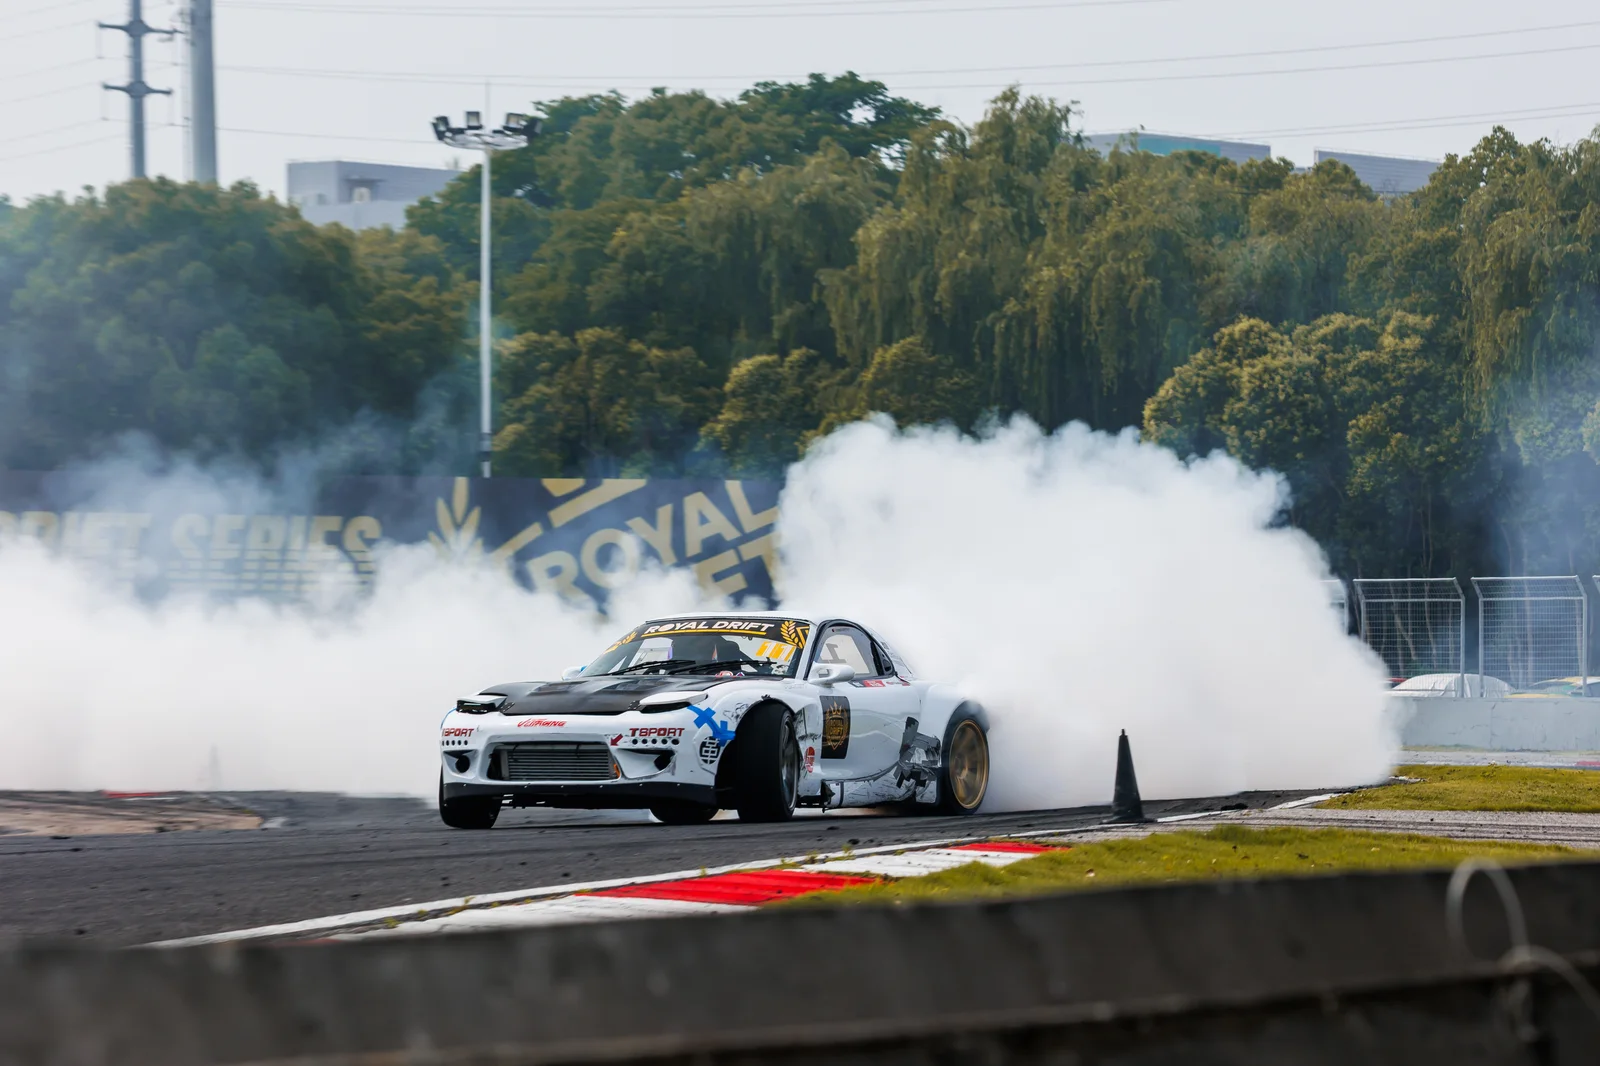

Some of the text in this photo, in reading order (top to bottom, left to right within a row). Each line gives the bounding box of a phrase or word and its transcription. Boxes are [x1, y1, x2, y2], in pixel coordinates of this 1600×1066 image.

[165, 514, 382, 599] SERIES
[525, 479, 779, 603] ROYAL
[644, 621, 775, 634] ROYAL DRIFT
